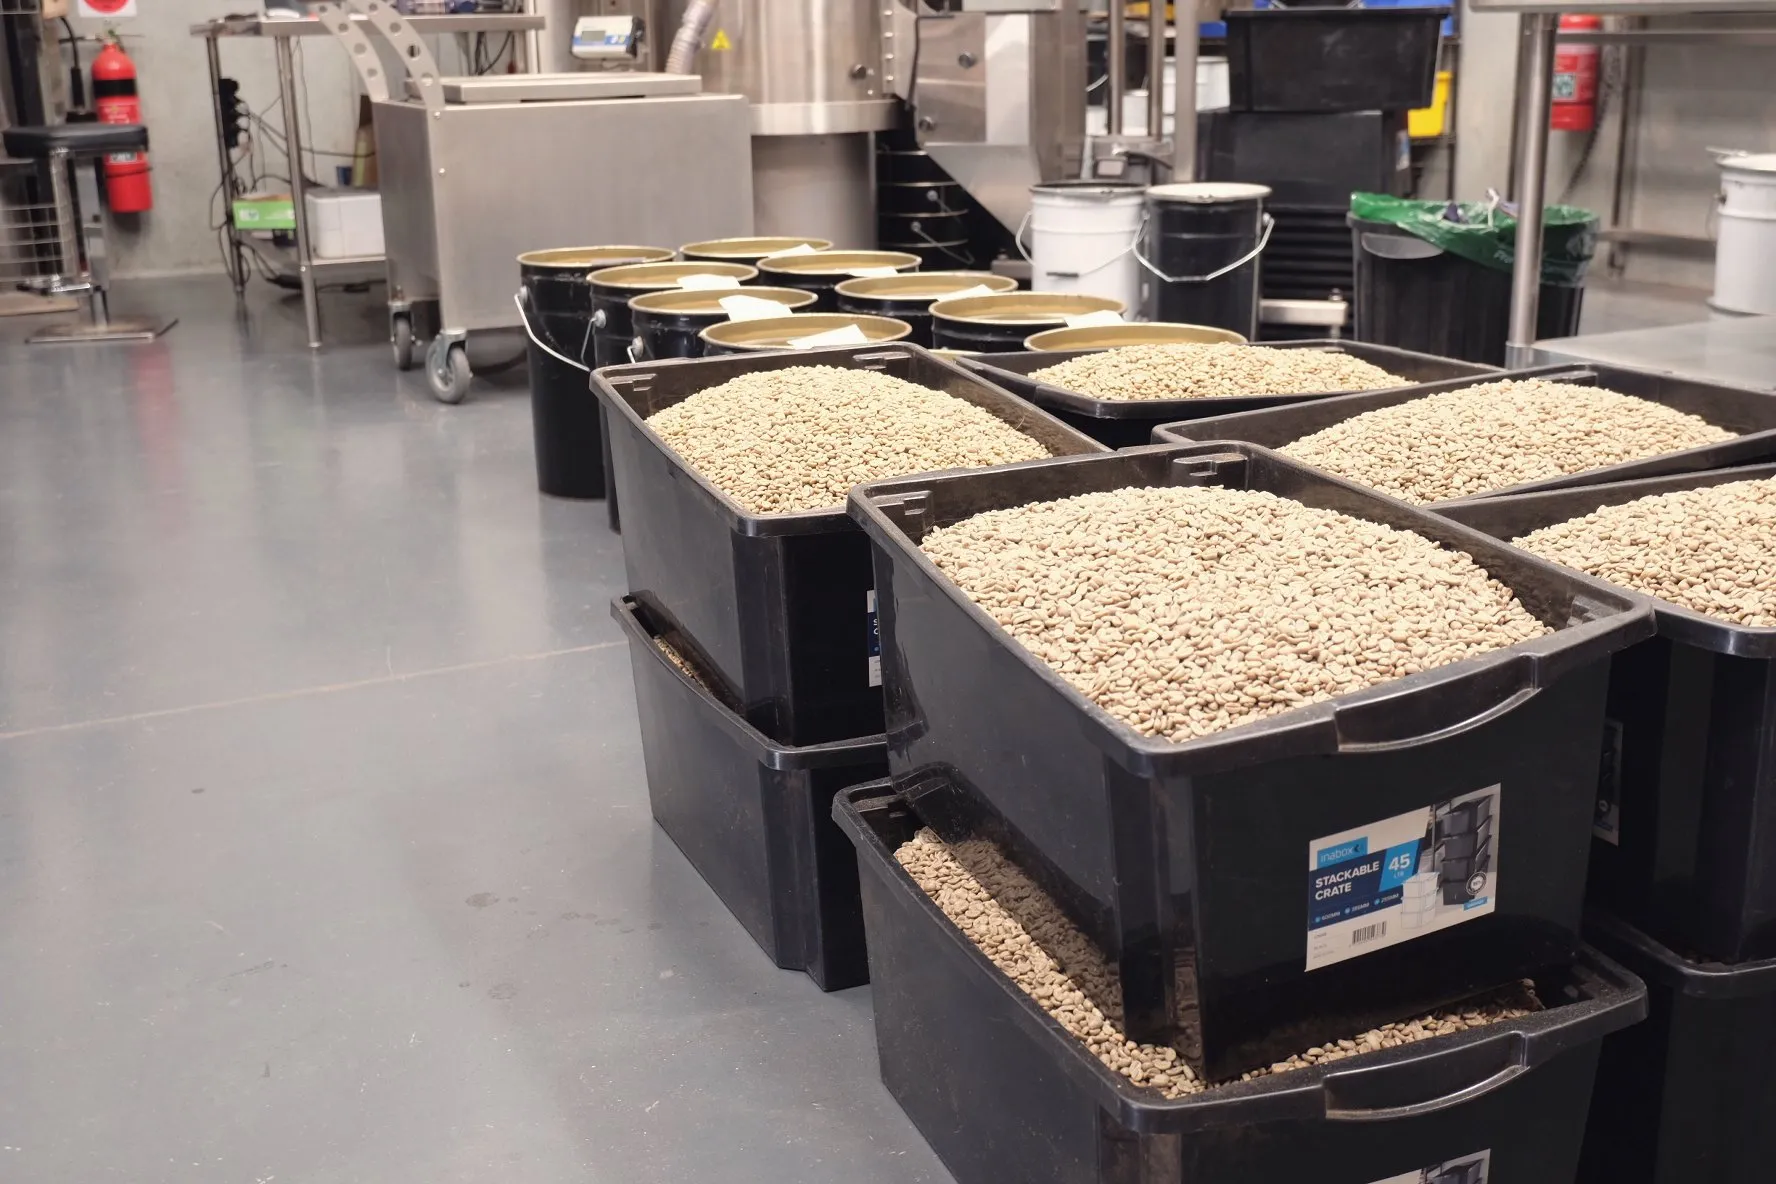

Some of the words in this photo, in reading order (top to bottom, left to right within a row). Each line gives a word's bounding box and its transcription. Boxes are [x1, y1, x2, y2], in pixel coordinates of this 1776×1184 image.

[1320, 846, 1353, 862] inabox
[1388, 853, 1411, 871] 45
[1315, 861, 1380, 888] STACKABLE
[1315, 882, 1352, 900] CRATE
